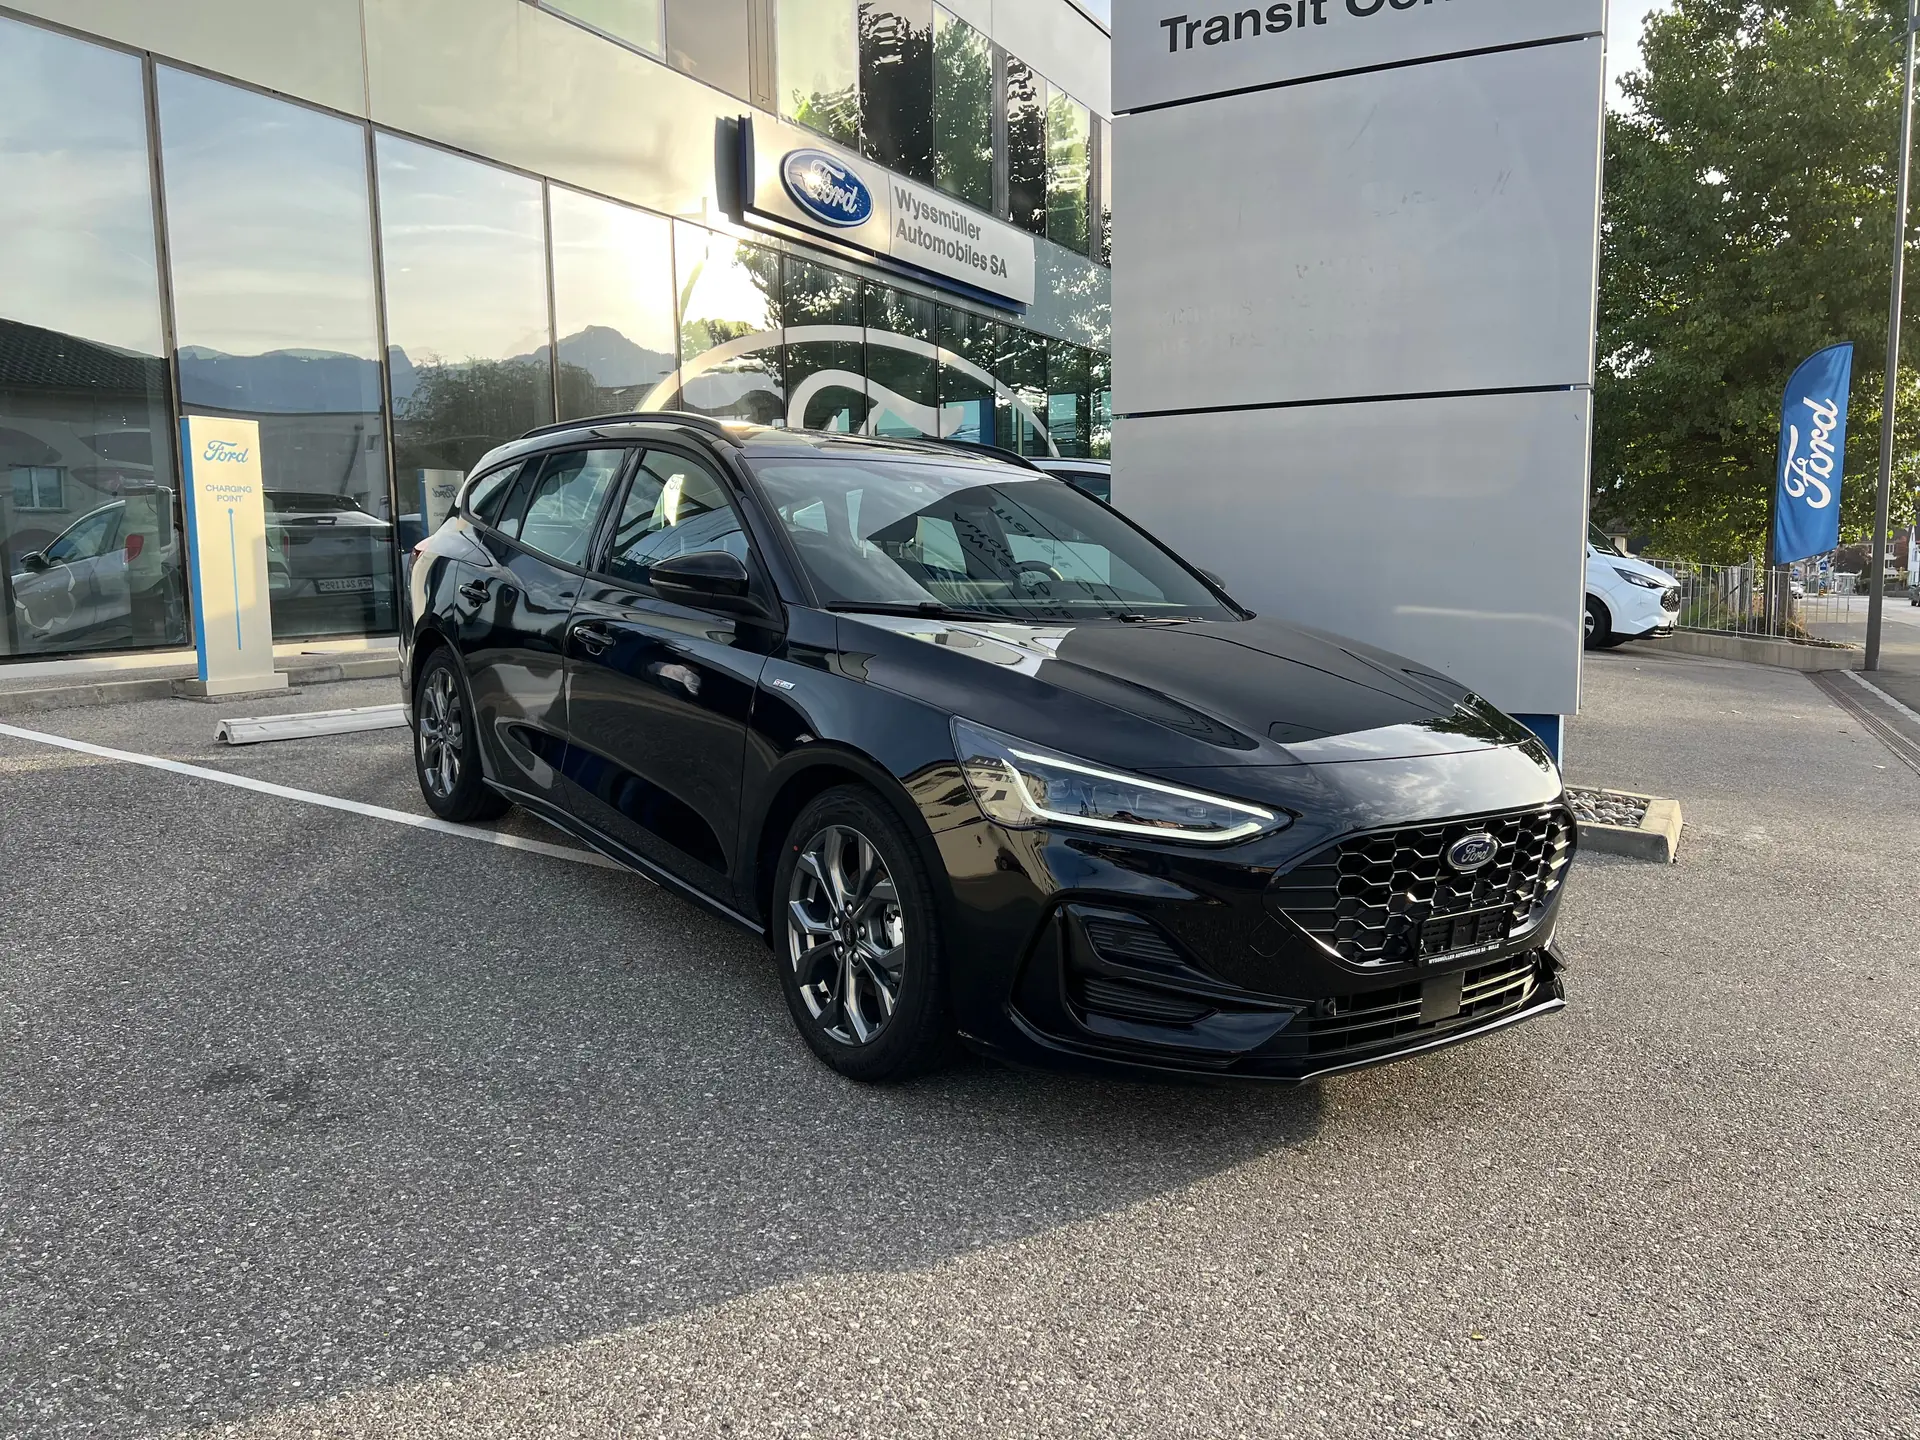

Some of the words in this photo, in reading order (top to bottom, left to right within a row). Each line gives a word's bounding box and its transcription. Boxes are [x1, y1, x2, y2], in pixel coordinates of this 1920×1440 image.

[1160, 0, 1327, 53] Transit
[804, 158, 859, 215] Ford
[894, 185, 981, 241] Wyssmüller
[896, 218, 987, 272] Automobiles
[990, 254, 1008, 279] SA
[203, 440, 249, 463] Ford
[1784, 396, 1839, 509] Ford
[205, 484, 253, 493] CHARGING
[216, 494, 243, 502] POINT
[1461, 843, 1489, 863] Ford
